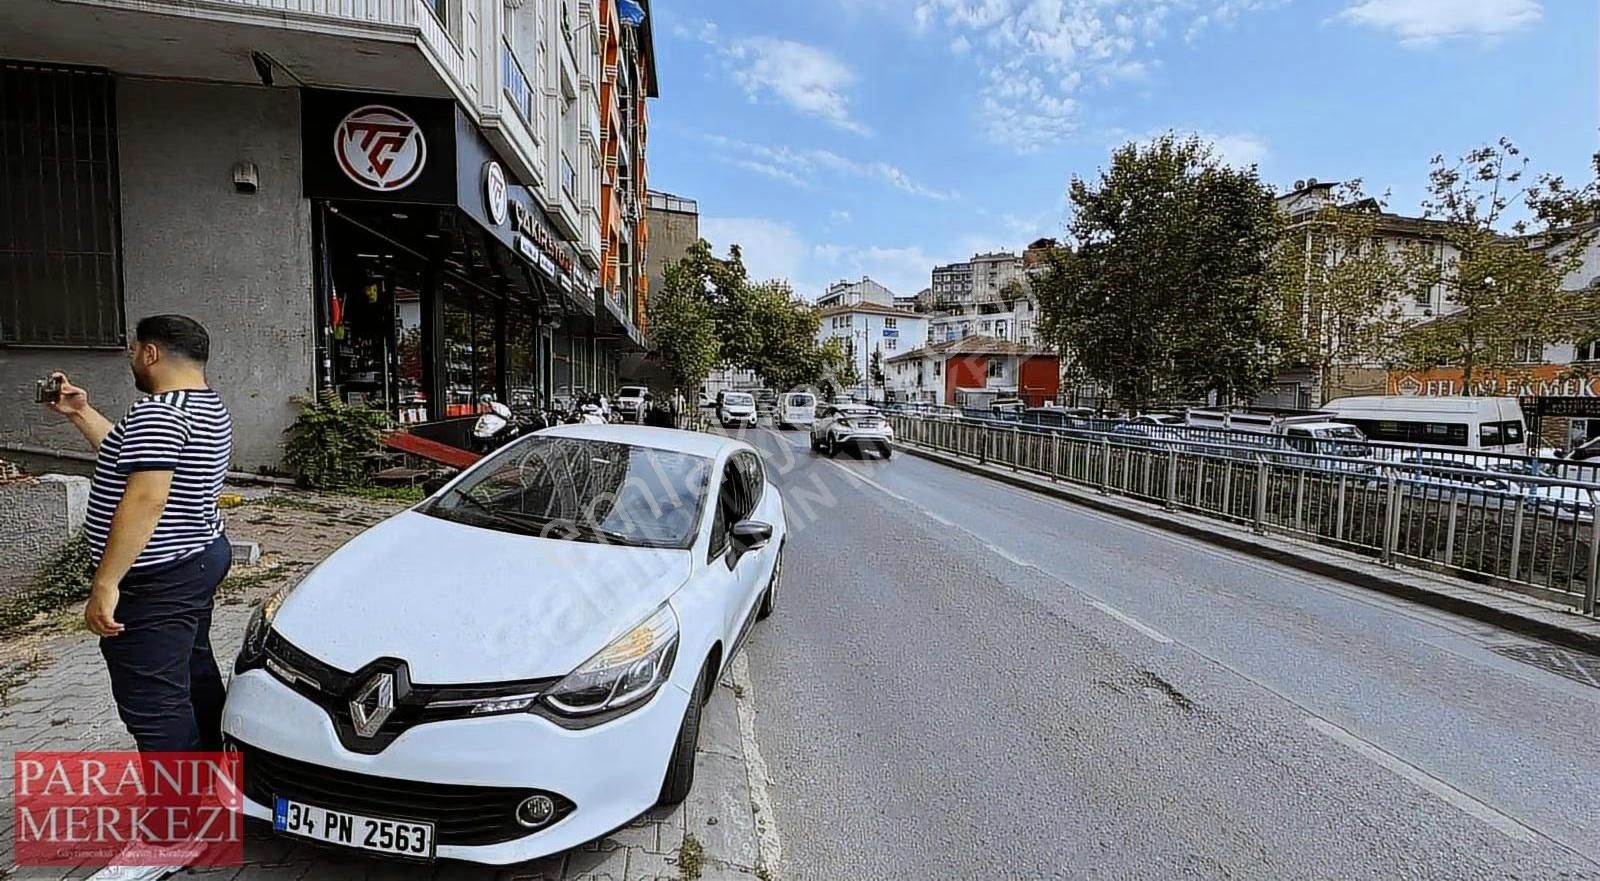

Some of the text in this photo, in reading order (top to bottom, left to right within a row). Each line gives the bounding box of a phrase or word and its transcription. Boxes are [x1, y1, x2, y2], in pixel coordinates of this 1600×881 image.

[1506, 379, 1600, 397] EKMEK
[288, 804, 315, 834] 34
[324, 811, 354, 843] PN
[363, 820, 426, 853] 2563
